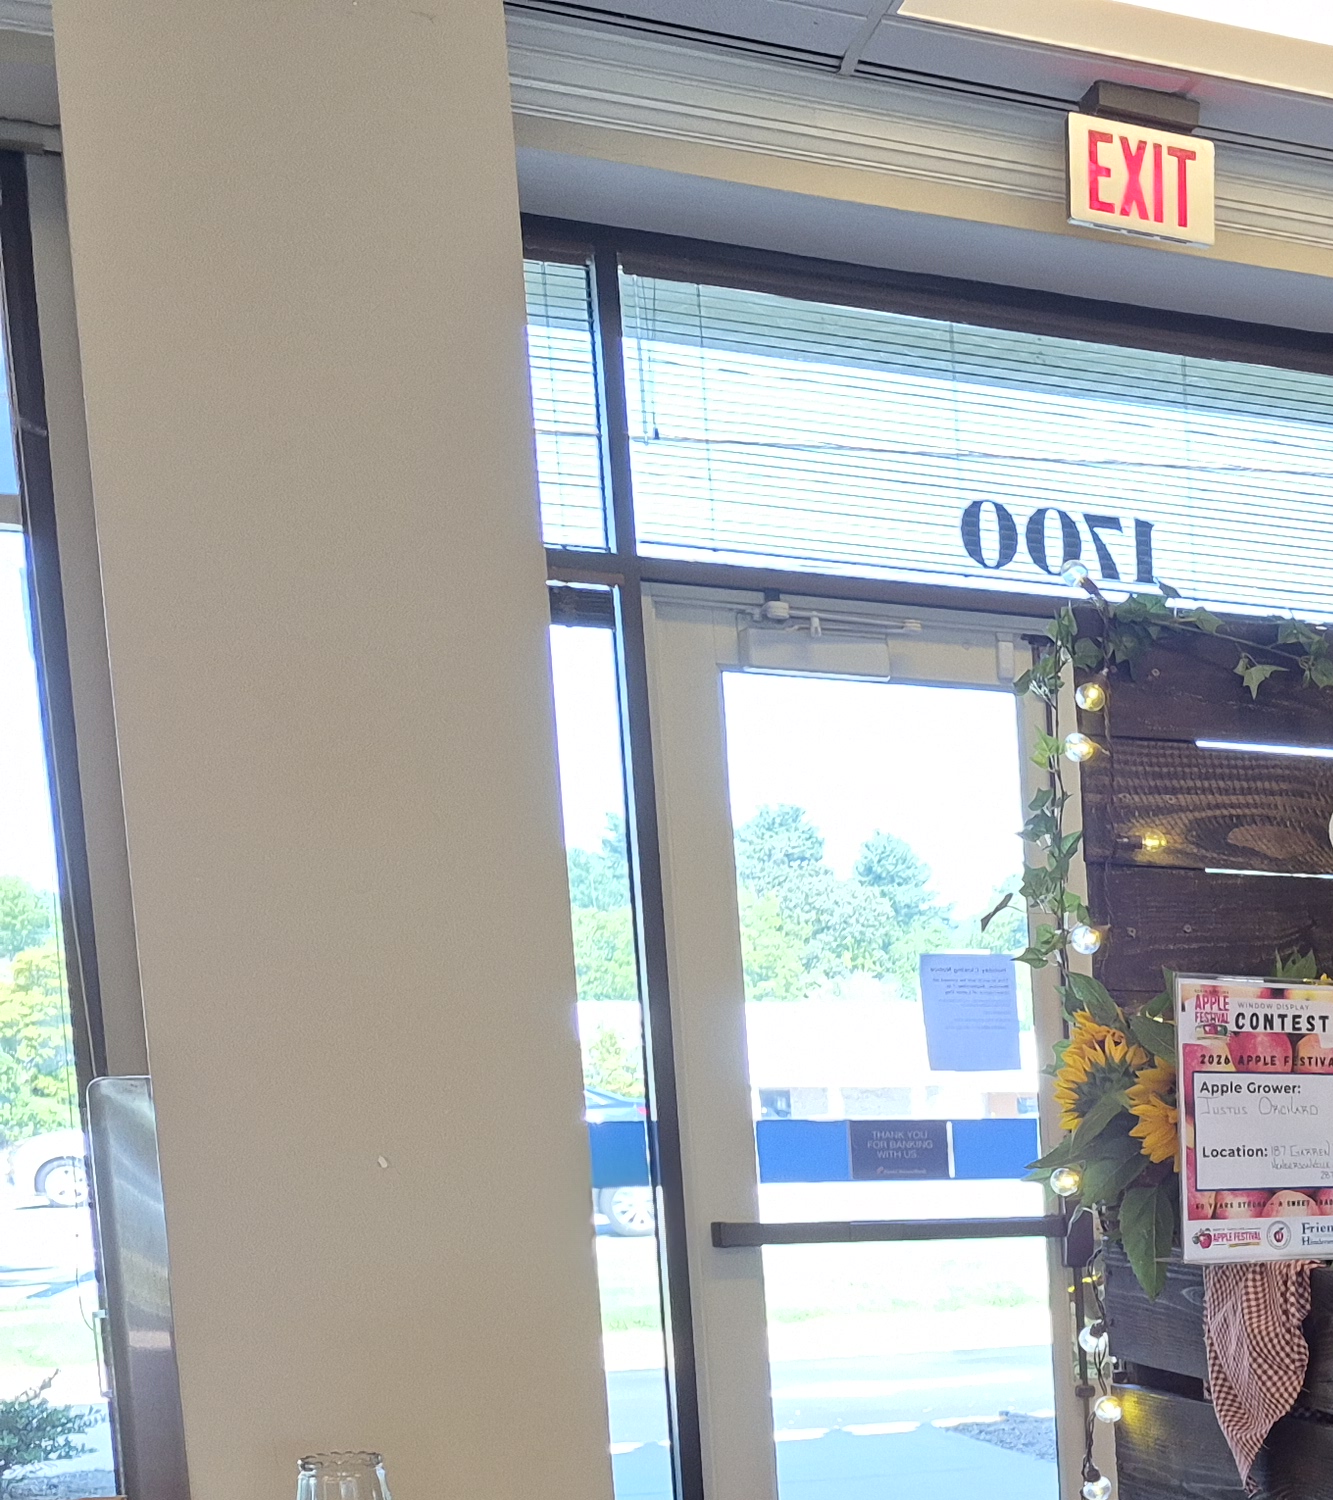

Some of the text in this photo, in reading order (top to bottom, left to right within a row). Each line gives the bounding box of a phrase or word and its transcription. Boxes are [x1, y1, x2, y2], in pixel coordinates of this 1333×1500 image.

[1087, 129, 1196, 228] EXIT
[1194, 994, 1230, 1012] APPLE
[1237, 1002, 1309, 1011] WINDOW DISPLAY
[1194, 1011, 1230, 1025] FESTIVAL
[1235, 1012, 1329, 1033] CONTEST
[1200, 1053, 1231, 1066] 2026
[1238, 1054, 1277, 1066] APPLE
[1200, 1081, 1301, 1096] Apple Grower:
[871, 1130, 928, 1140] THANK YOU
[867, 1139, 933, 1150] FOR BANKING
[876, 1149, 901, 1159] WITH
[1202, 1145, 1268, 1158] Location:
